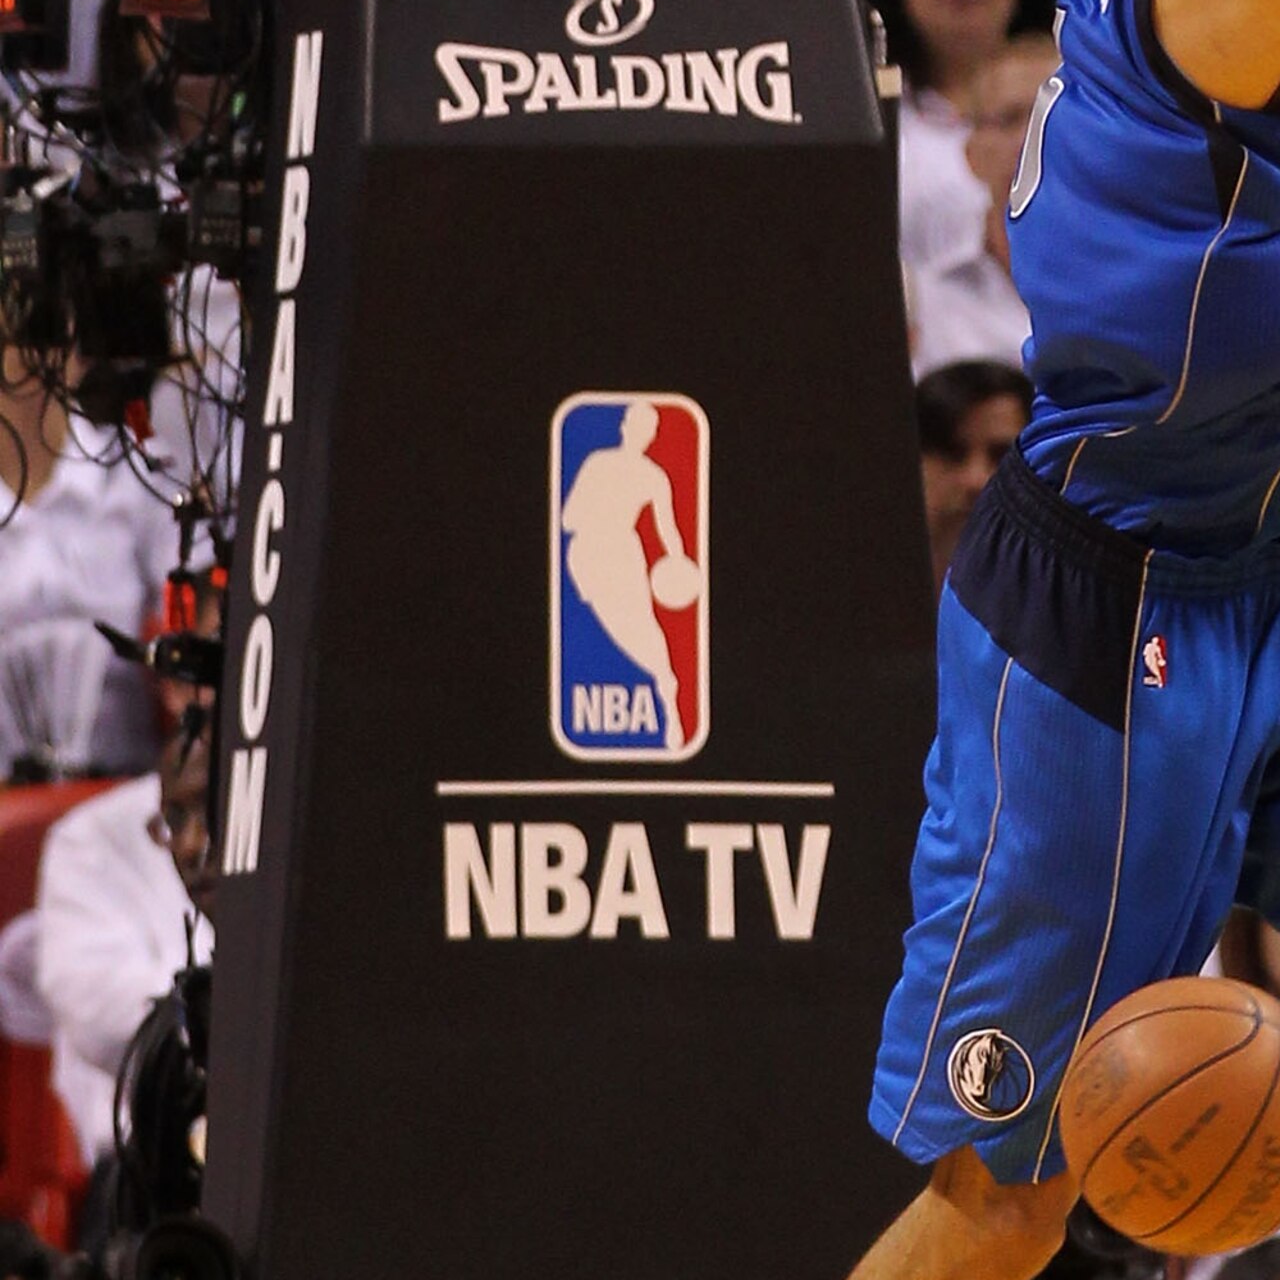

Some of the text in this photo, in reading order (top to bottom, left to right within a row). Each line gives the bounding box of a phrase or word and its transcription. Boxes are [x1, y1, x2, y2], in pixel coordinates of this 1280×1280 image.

[435, 41, 803, 124] SPALDING
[222, 30, 323, 876] NBA.COM
[571, 682, 660, 734] NBA
[443, 822, 831, 941] NBA TV
